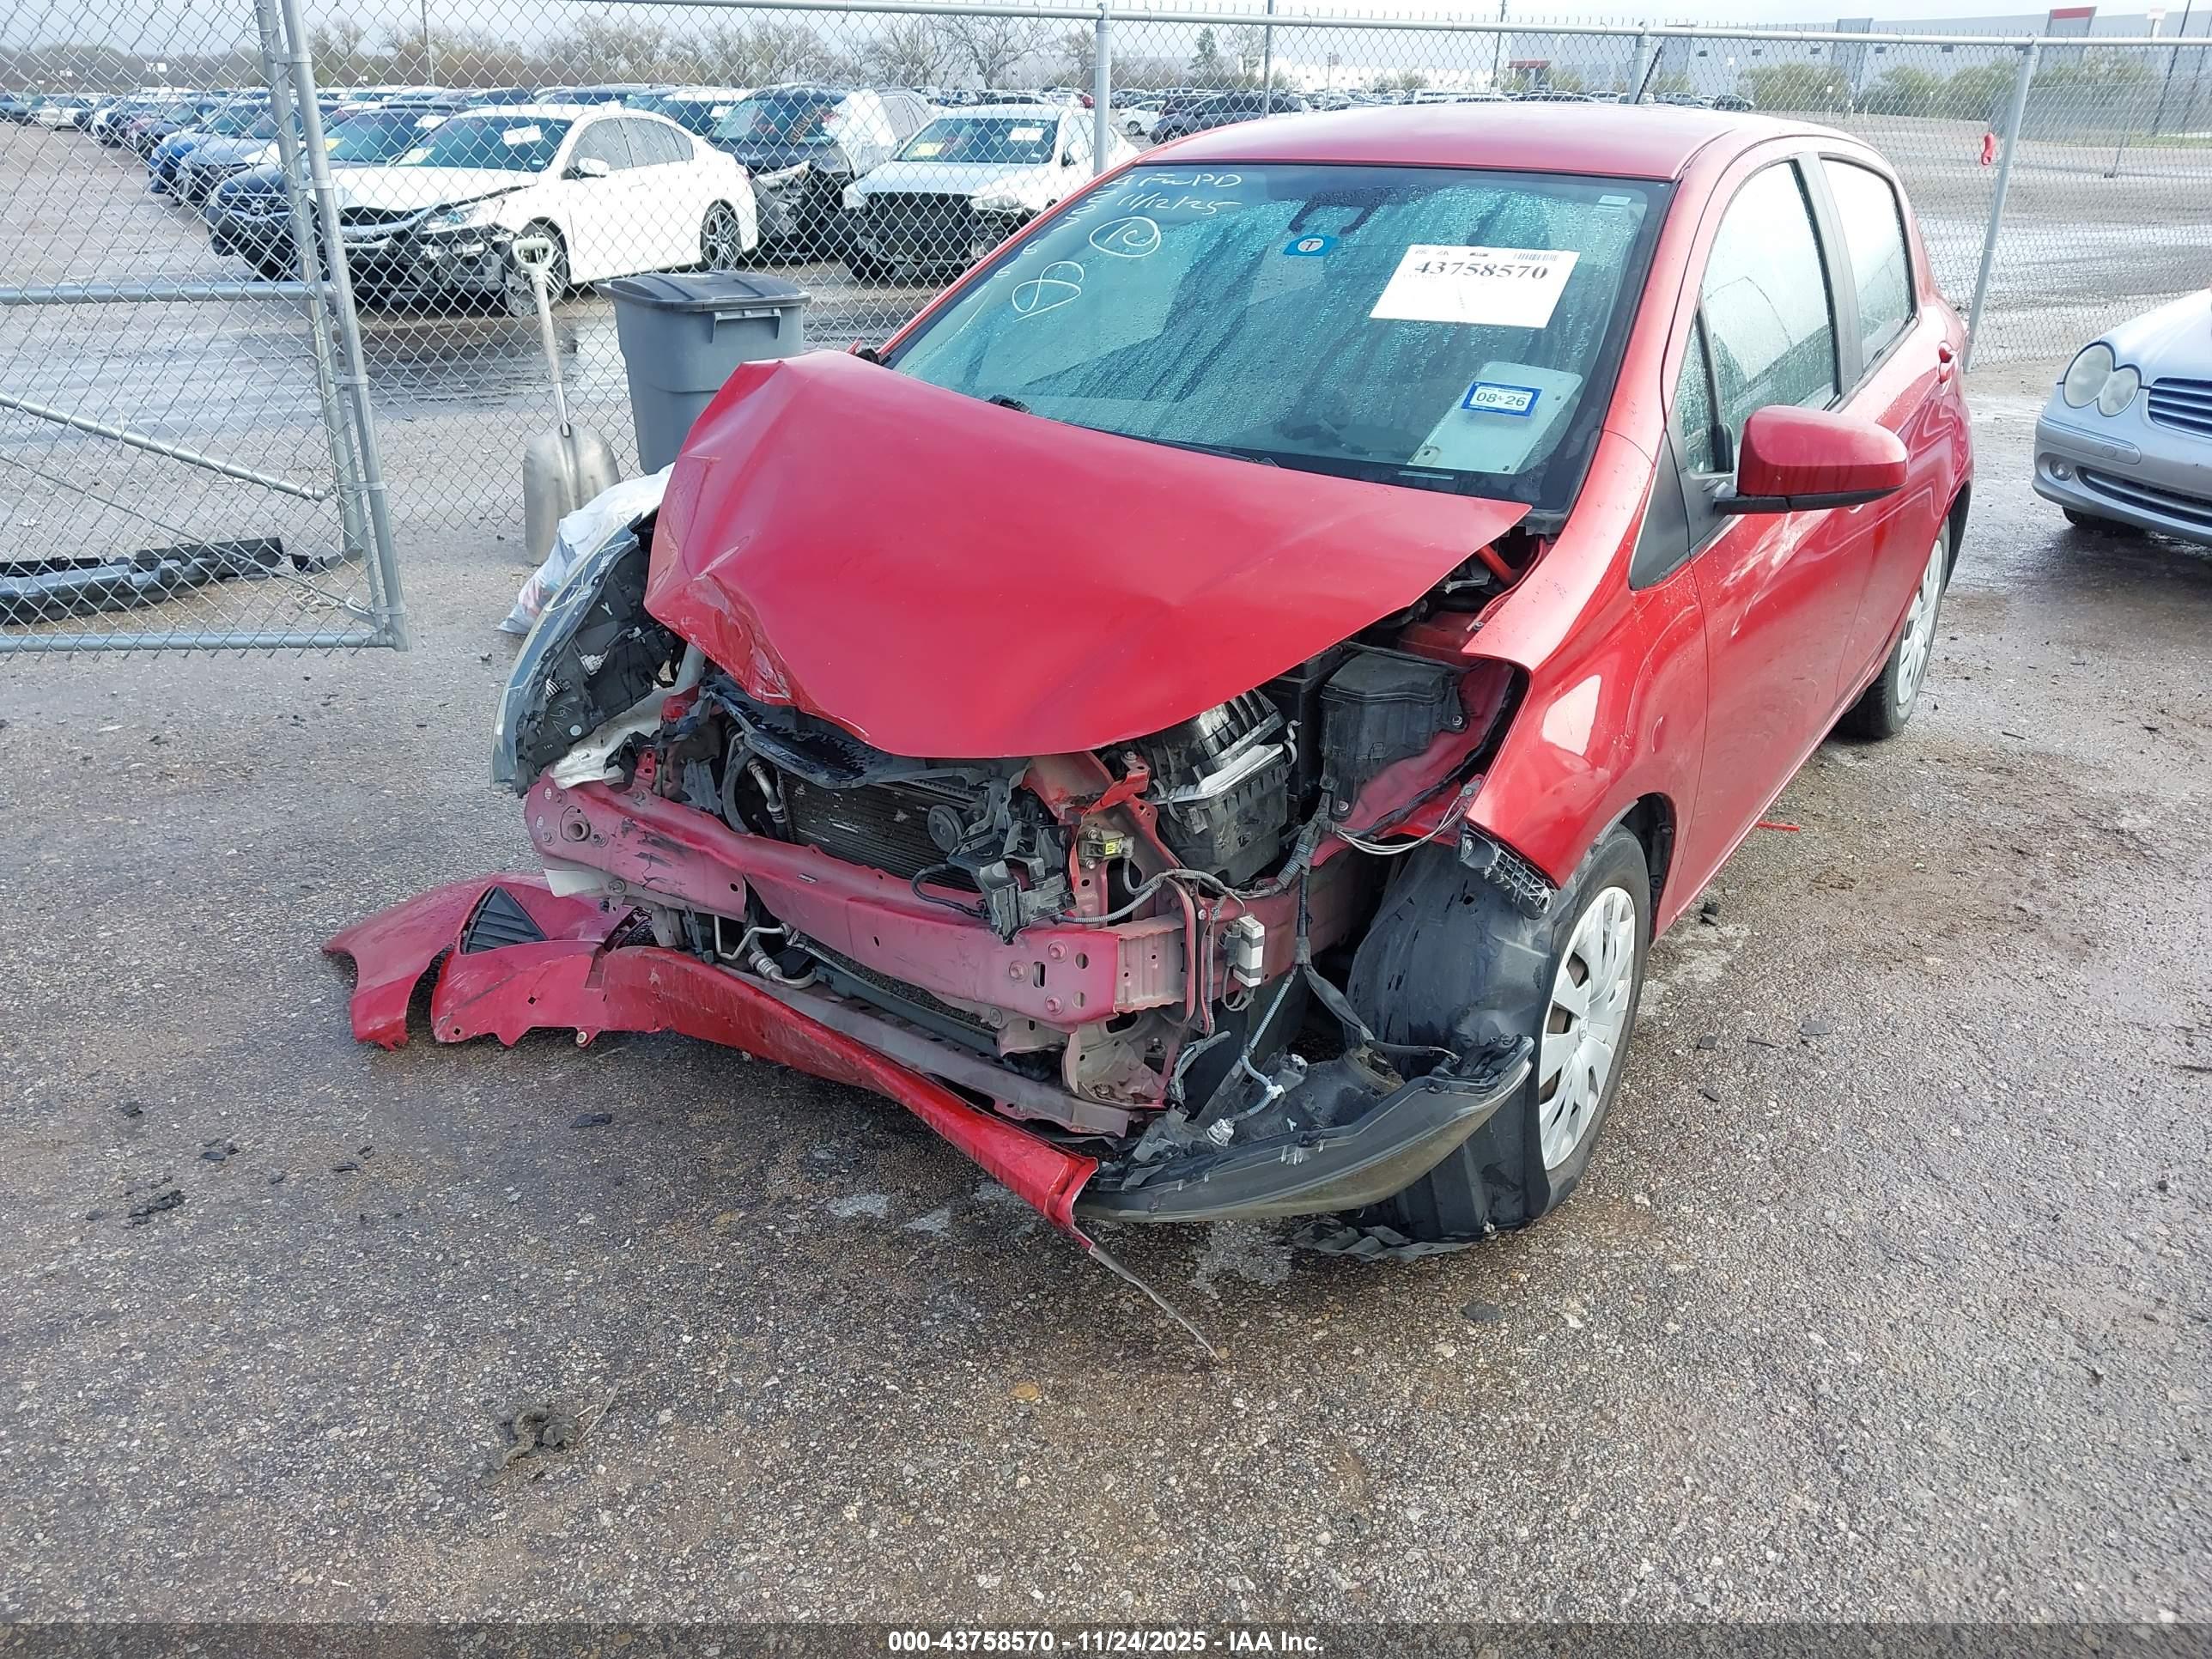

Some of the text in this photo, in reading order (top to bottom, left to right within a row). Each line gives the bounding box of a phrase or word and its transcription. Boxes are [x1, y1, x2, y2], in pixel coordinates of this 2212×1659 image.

[1414, 260, 1549, 280] 43758570
[1476, 392, 1498, 403] 08
[1504, 395, 1527, 407] 26
